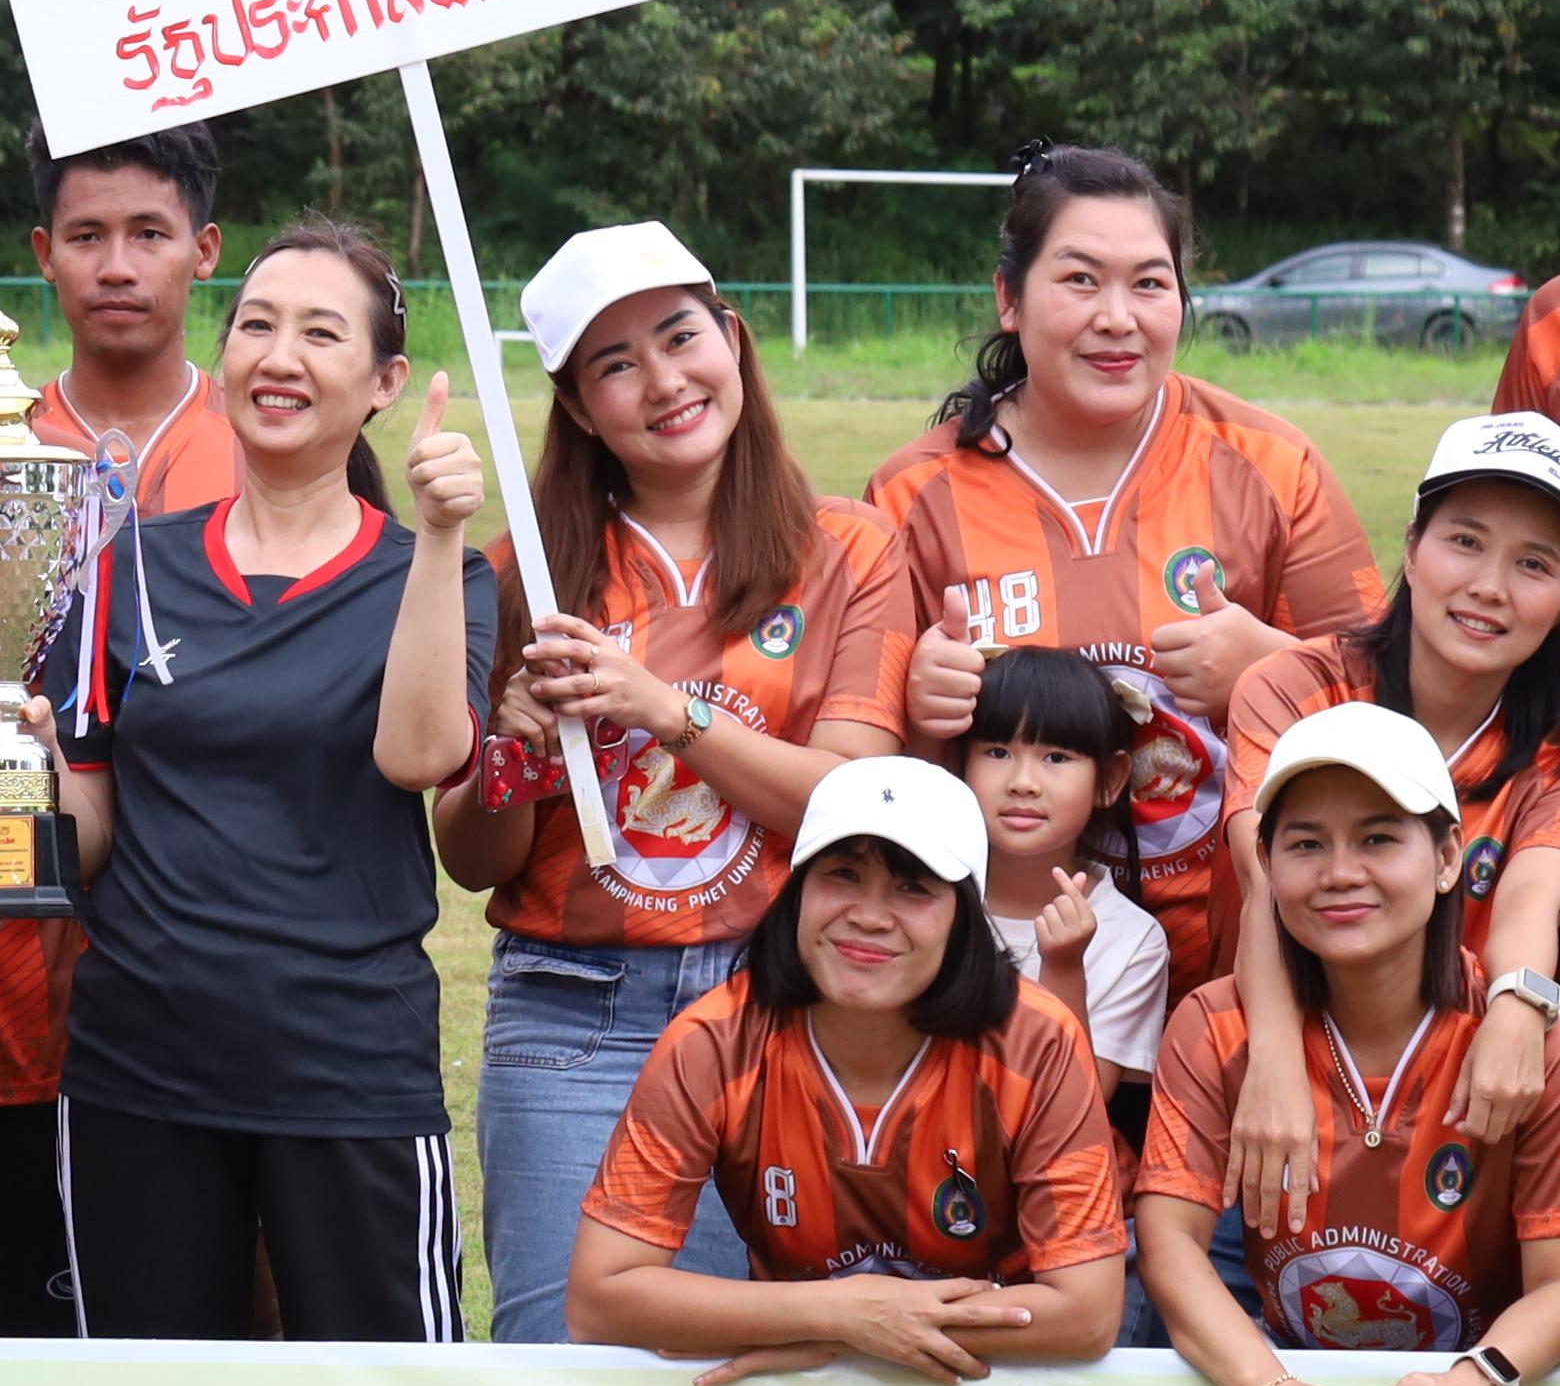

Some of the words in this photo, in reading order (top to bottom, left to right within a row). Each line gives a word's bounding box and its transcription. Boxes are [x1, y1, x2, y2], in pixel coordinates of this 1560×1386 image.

[589, 867, 678, 912] KAMPHAENG
[688, 882, 728, 909] PHET
[729, 826, 767, 885] UNIVER
[764, 1166, 798, 1228] 8
[1264, 1237, 1304, 1273] PUBLIC
[1311, 1225, 1471, 1296] ADMINISTRATION
